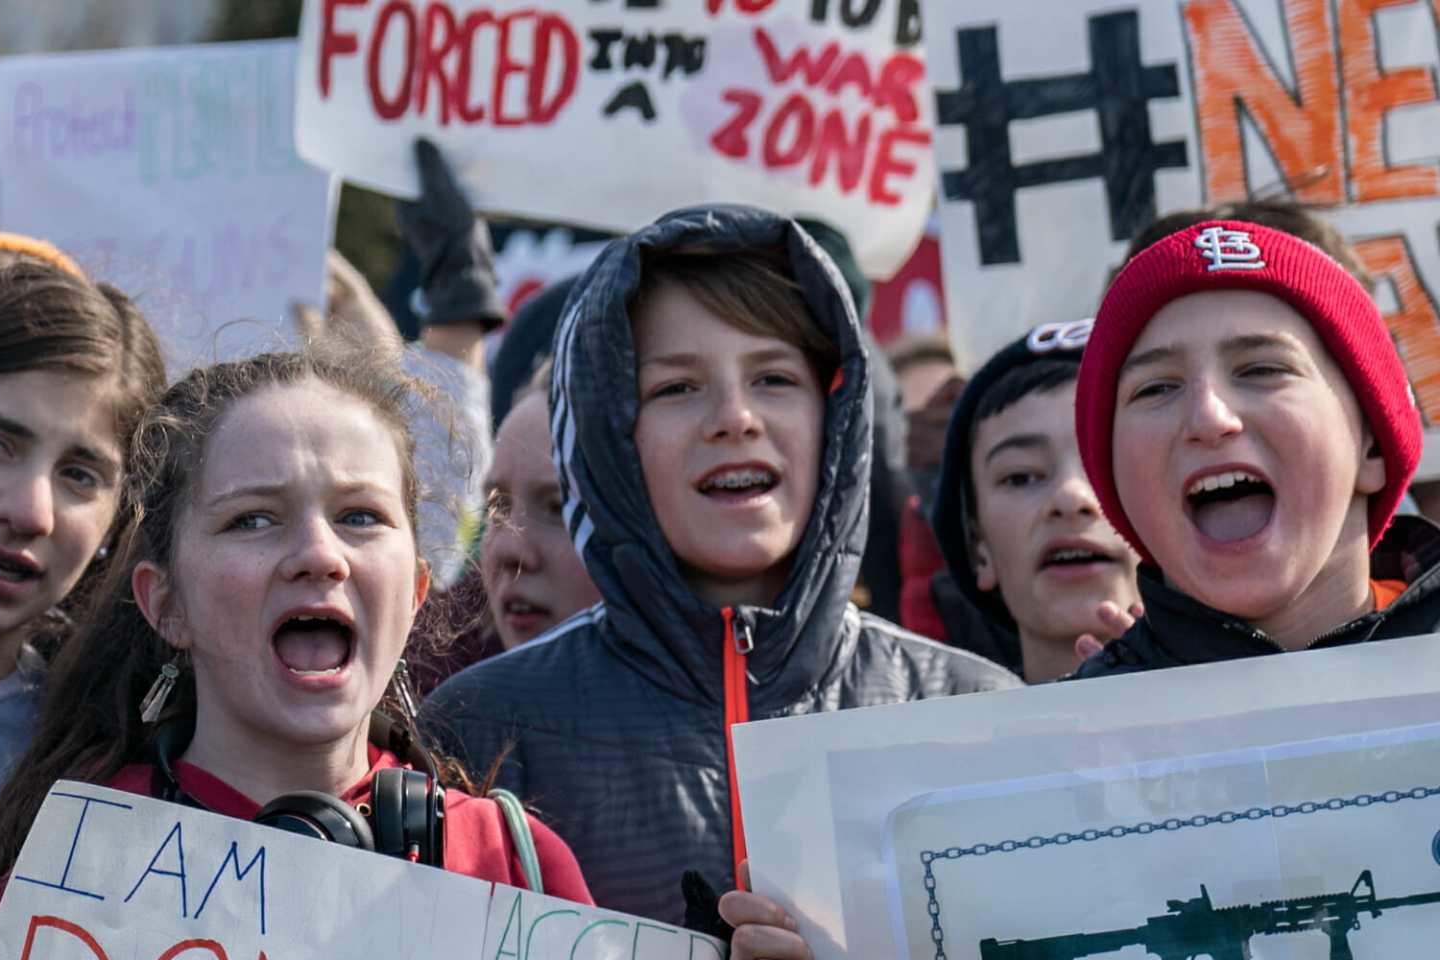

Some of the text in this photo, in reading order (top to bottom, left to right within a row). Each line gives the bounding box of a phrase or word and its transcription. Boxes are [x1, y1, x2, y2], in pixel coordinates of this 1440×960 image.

[317, 0, 581, 128] FORCED
[602, 80, 657, 122] A
[752, 26, 927, 126] WAR
[709, 88, 933, 207] ZONE
[15, 791, 266, 935] I AM
